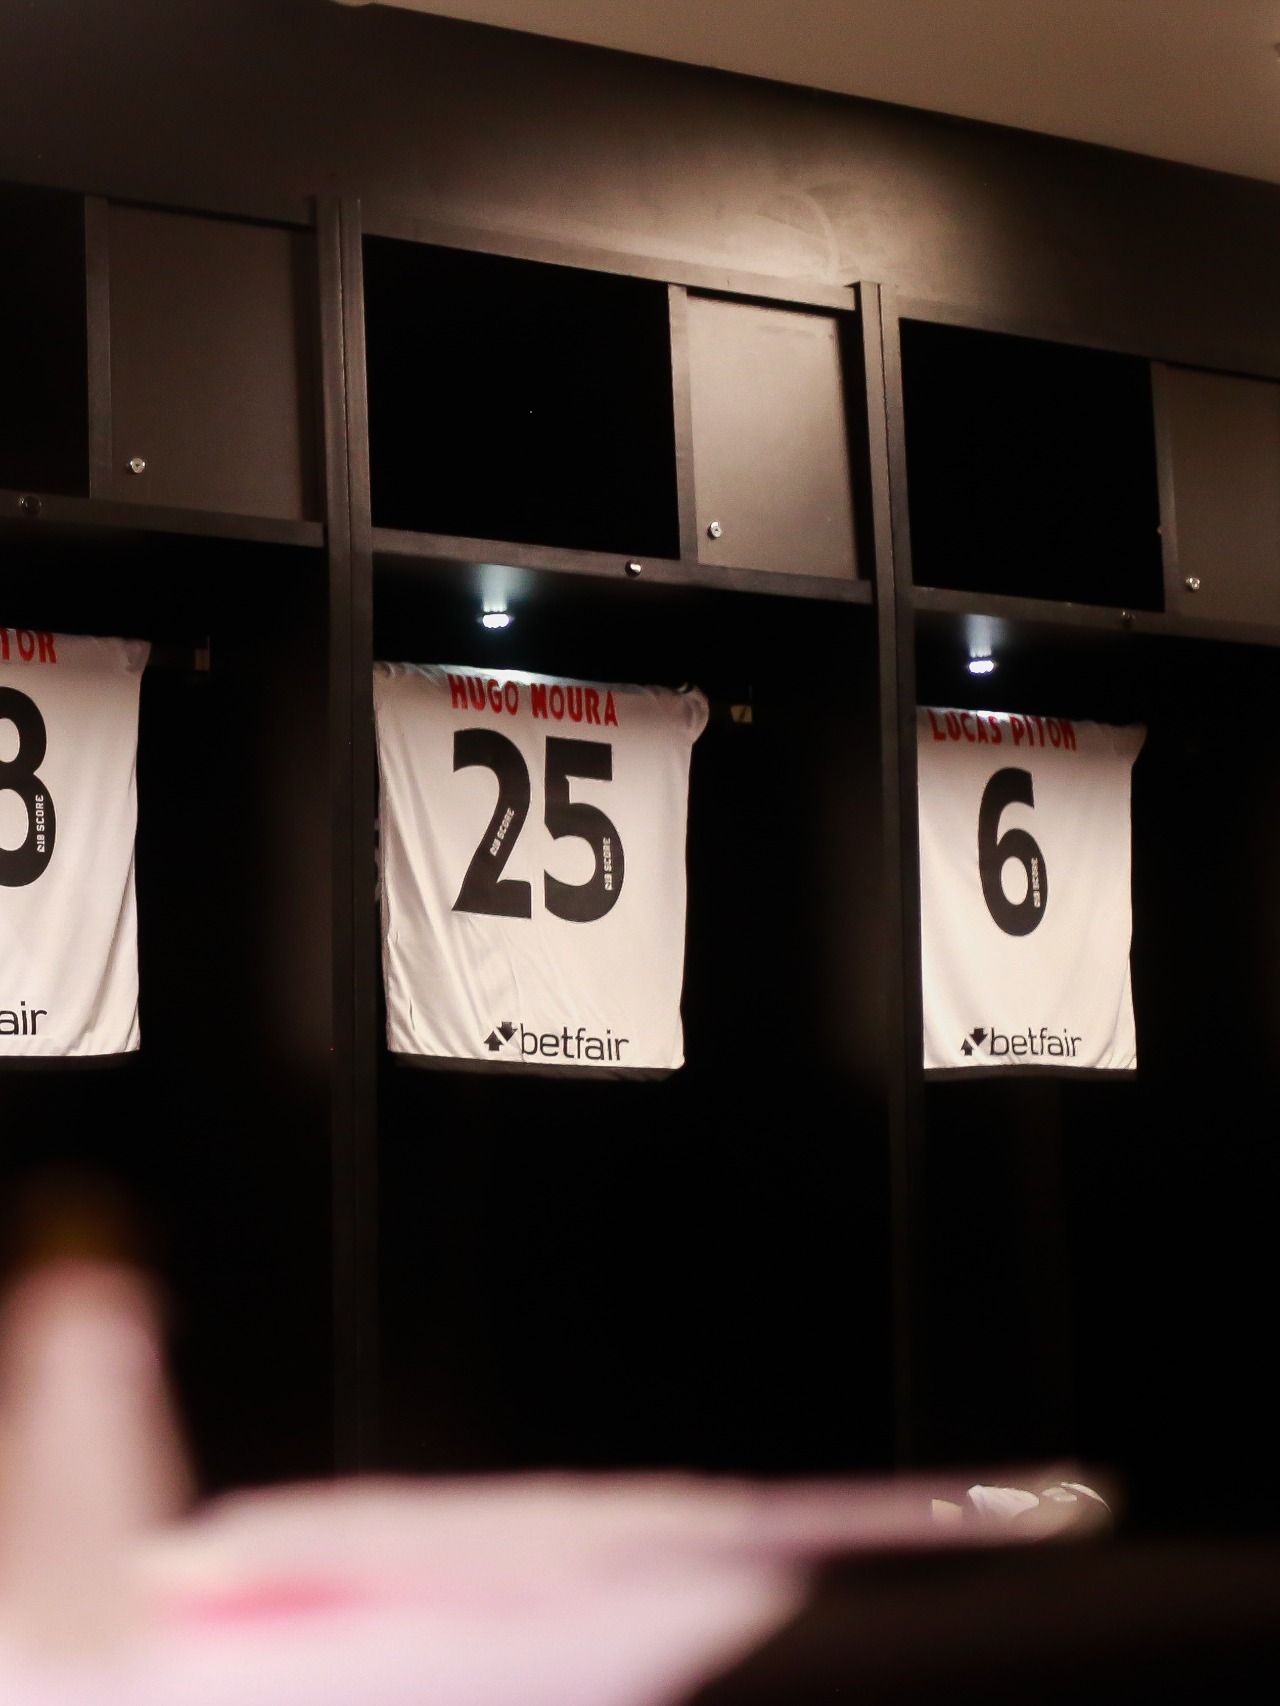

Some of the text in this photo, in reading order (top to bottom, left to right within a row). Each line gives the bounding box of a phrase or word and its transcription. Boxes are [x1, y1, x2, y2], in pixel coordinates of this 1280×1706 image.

[447, 673, 618, 727] HUGO MOURA
[927, 709, 1002, 744] LUCAS
[35, 794, 44, 831] SCORE
[451, 728, 625, 923] 25
[978, 767, 1048, 937] 6
[520, 1022, 630, 1061] betfair
[990, 1027, 1082, 1056] betfair
